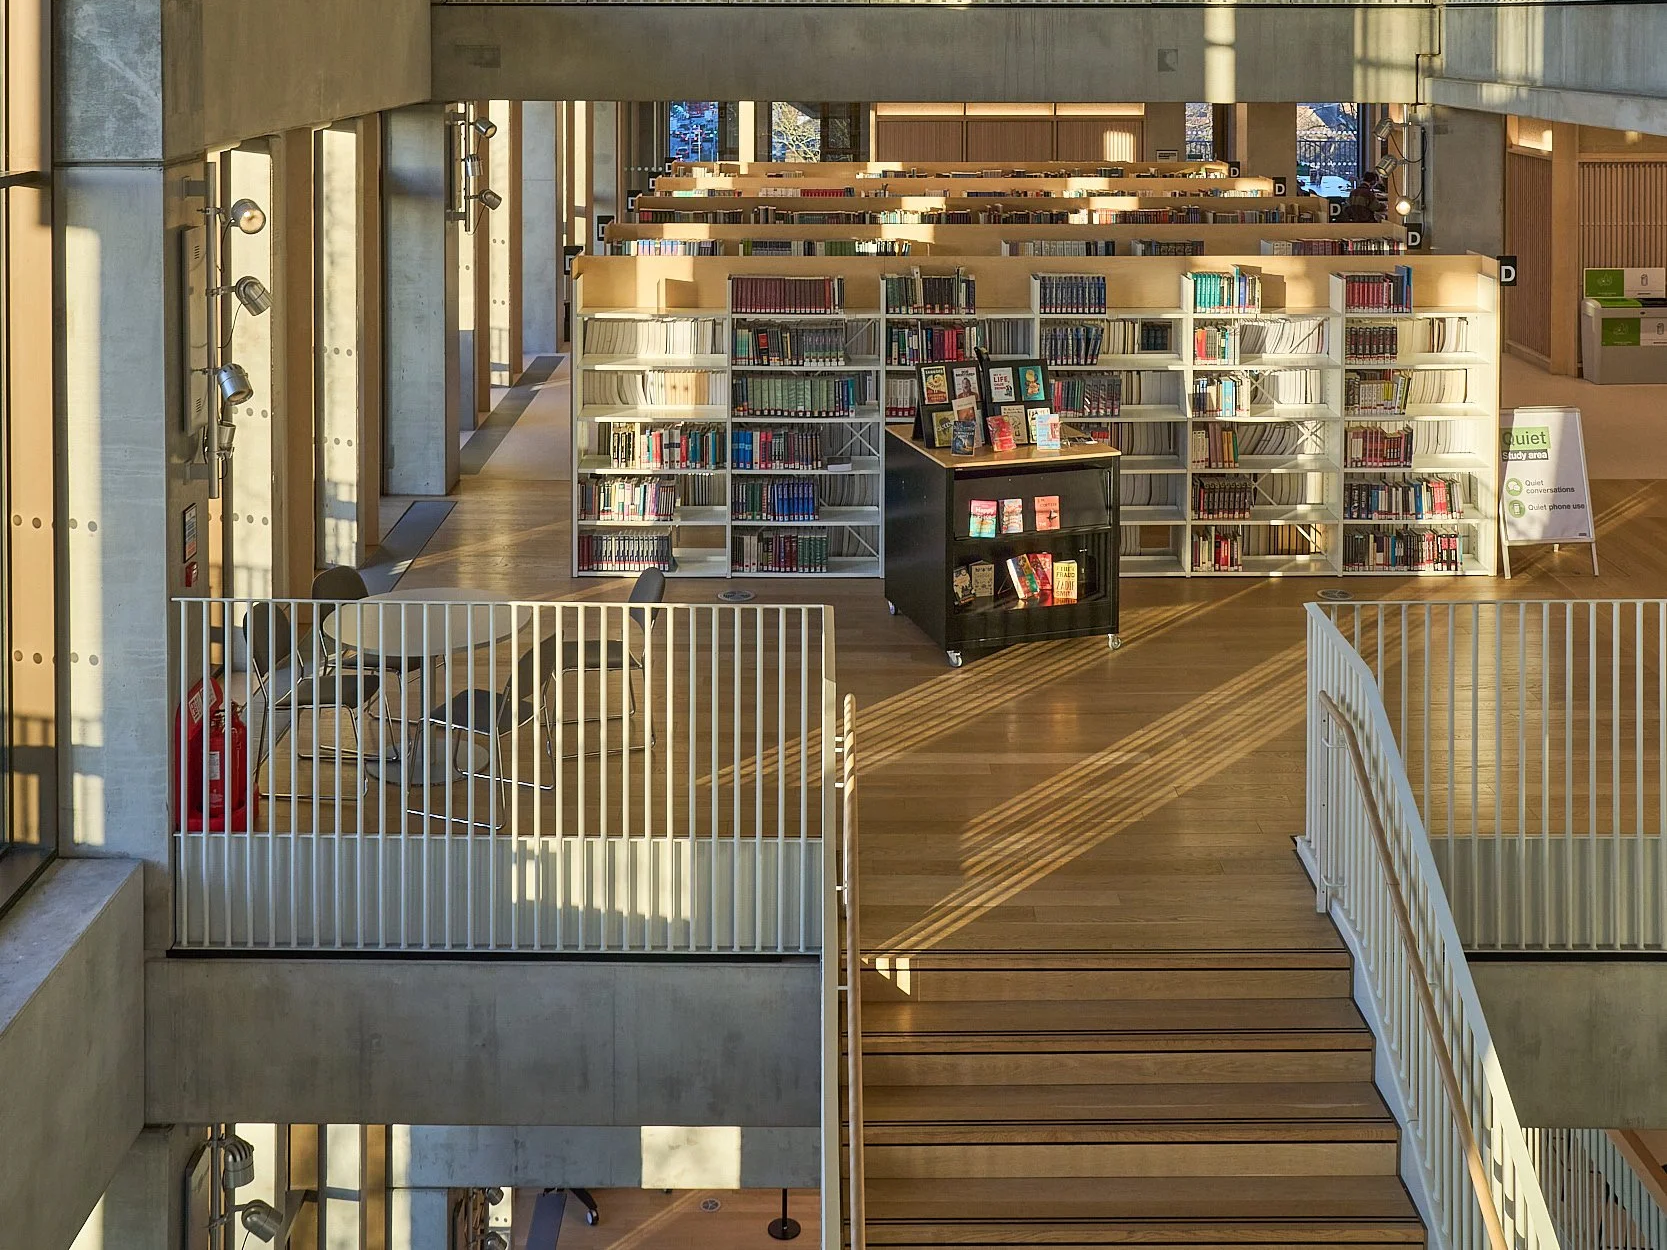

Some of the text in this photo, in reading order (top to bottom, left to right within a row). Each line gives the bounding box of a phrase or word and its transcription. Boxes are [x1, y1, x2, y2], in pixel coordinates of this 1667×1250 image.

[1230, 167, 1240, 177] D
[1275, 184, 1285, 194] D
[1330, 203, 1341, 216] D
[1408, 232, 1421, 246] D
[1501, 266, 1516, 282] D
[1502, 431, 1547, 446] Quiet
[1502, 451, 1526, 461] Study
[1526, 486, 1575, 494] conversations
[1549, 503, 1571, 511] phone
